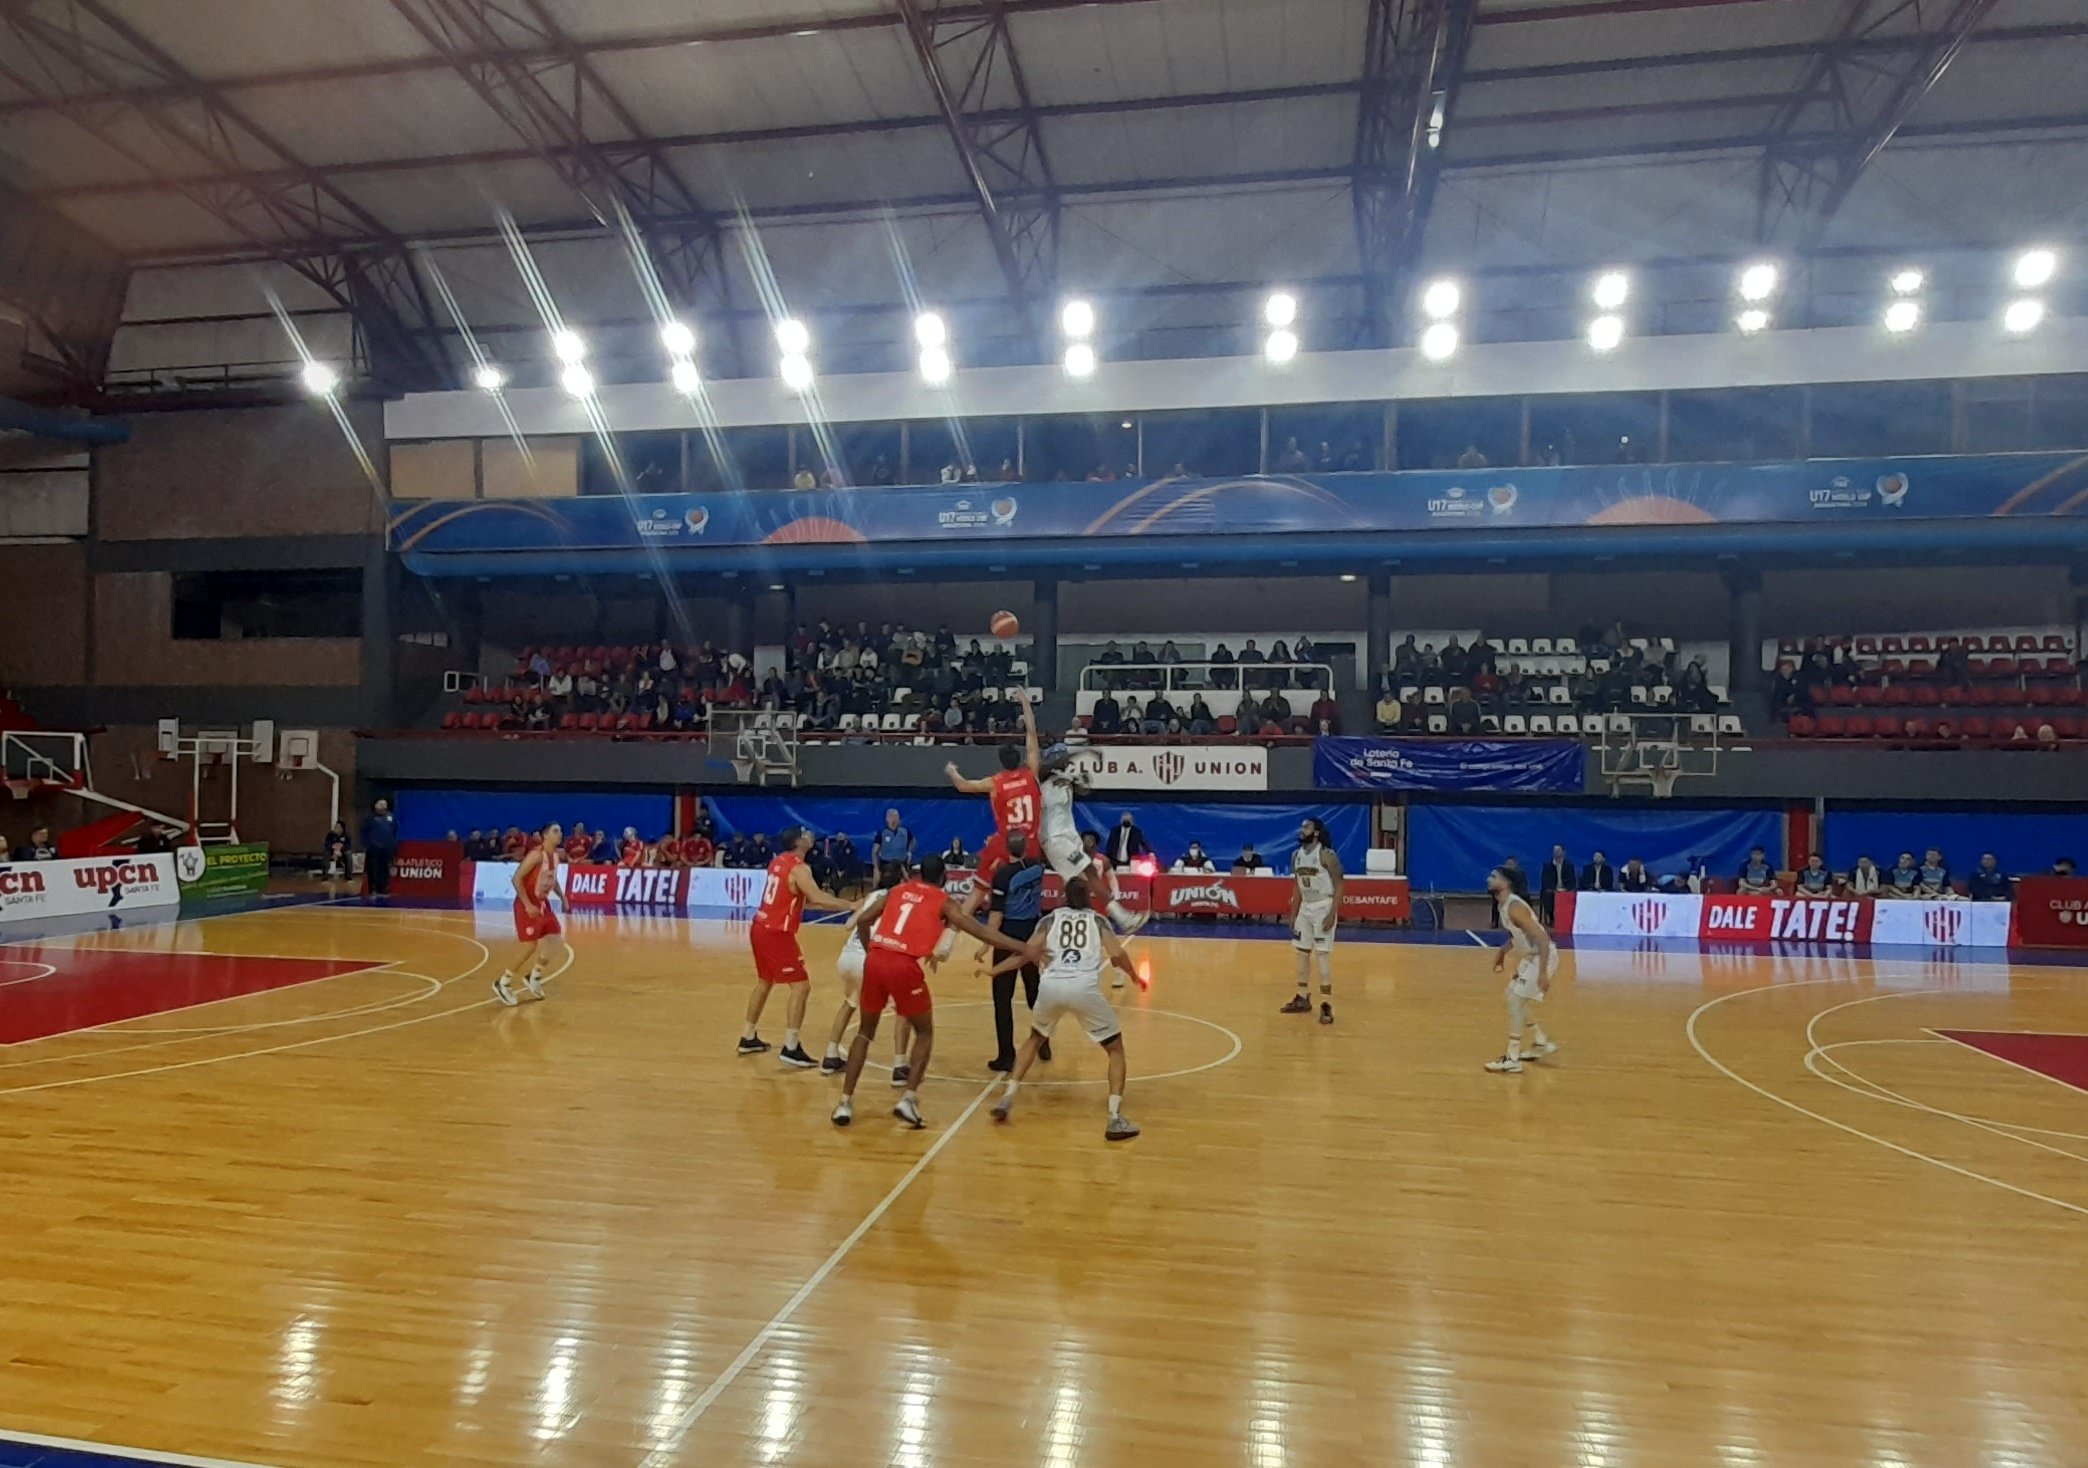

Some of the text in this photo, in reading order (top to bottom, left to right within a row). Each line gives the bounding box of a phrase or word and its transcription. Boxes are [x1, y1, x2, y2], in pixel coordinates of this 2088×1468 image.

[1126, 761, 1143, 774] A.
[1194, 761, 1262, 774] UNION
[1366, 757, 1398, 769] Santa
[1006, 794, 1034, 824] 31
[73, 862, 160, 895] upcn
[400, 866, 443, 879] UNIÓN
[571, 867, 681, 904] DALE TATE!
[893, 902, 914, 935] 1
[2049, 899, 2082, 911] CLUB
[1059, 919, 1088, 949] 88
[1708, 899, 1860, 942] DALE TATE!
